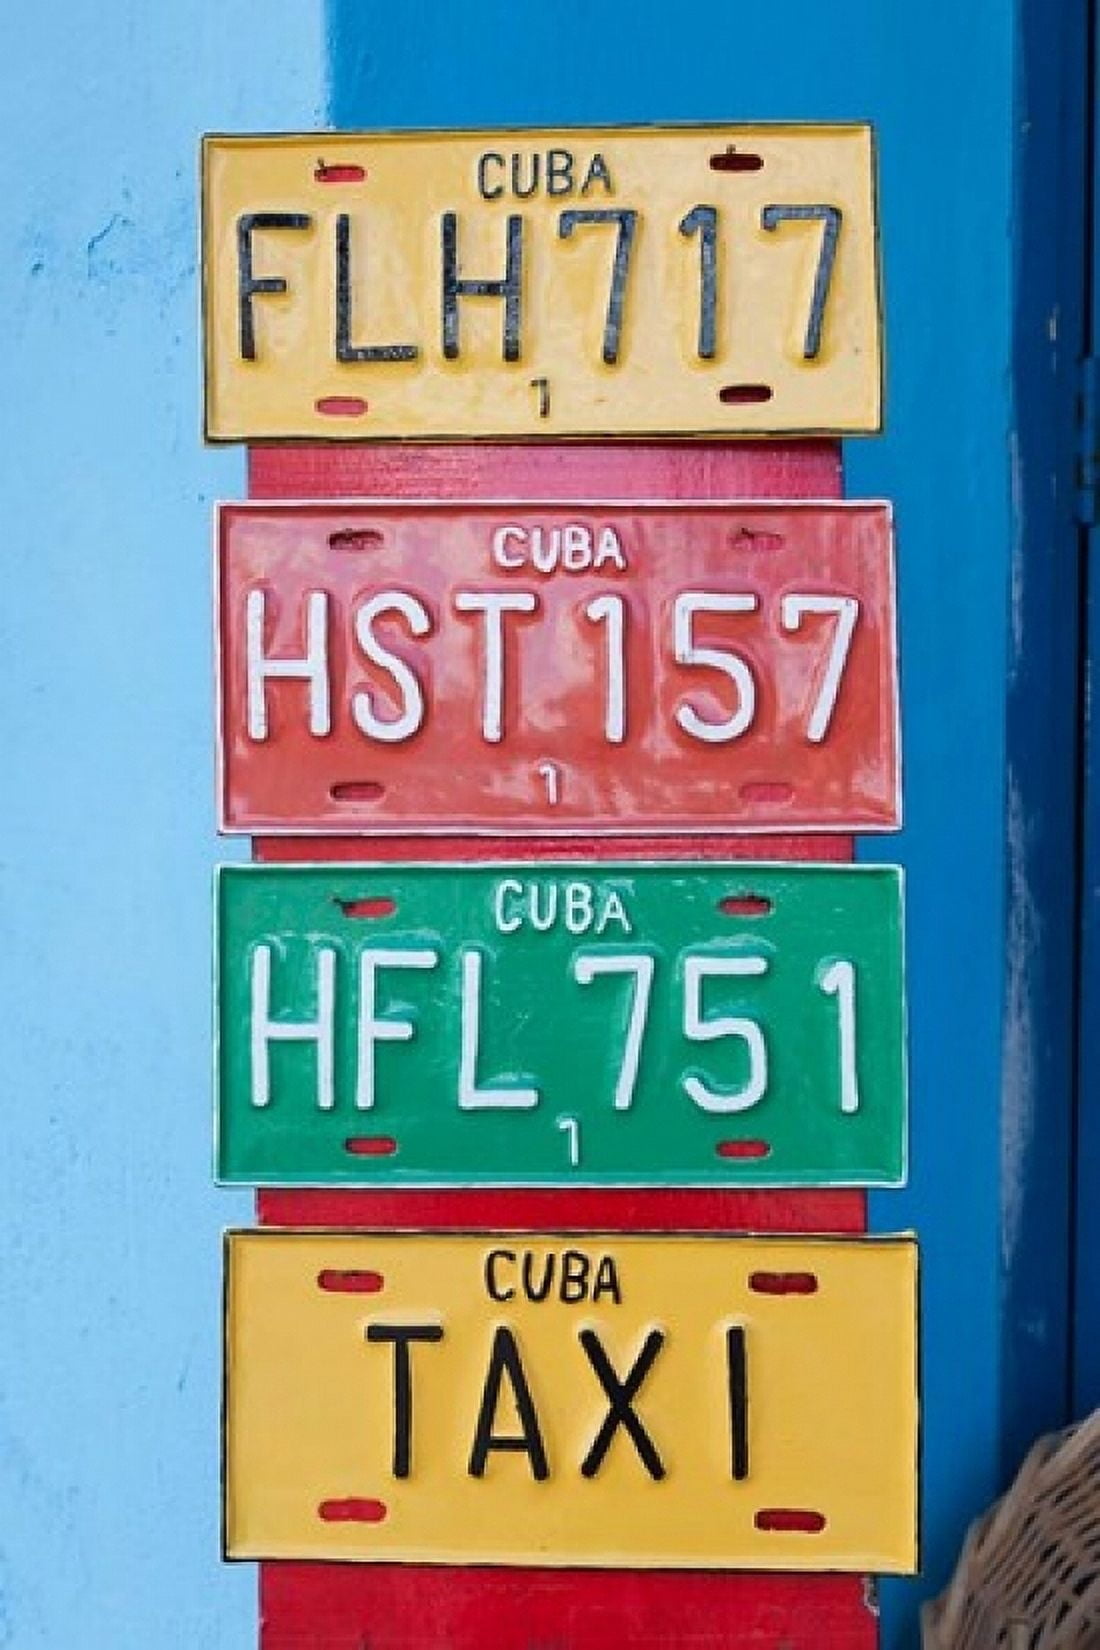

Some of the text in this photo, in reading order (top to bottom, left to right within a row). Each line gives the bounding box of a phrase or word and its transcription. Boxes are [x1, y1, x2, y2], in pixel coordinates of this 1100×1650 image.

[477, 150, 613, 199] CUBA
[236, 204, 842, 364] FLH717
[530, 378, 551, 419] 1
[493, 526, 627, 573] CUBA
[246, 589, 859, 743] HST157
[538, 764, 559, 805] 1
[494, 879, 632, 934] CUBA
[250, 944, 859, 1113] HFL751
[556, 1116, 579, 1166] 1
[485, 1250, 622, 1305] CUBA
[365, 1324, 749, 1481] TAXI
